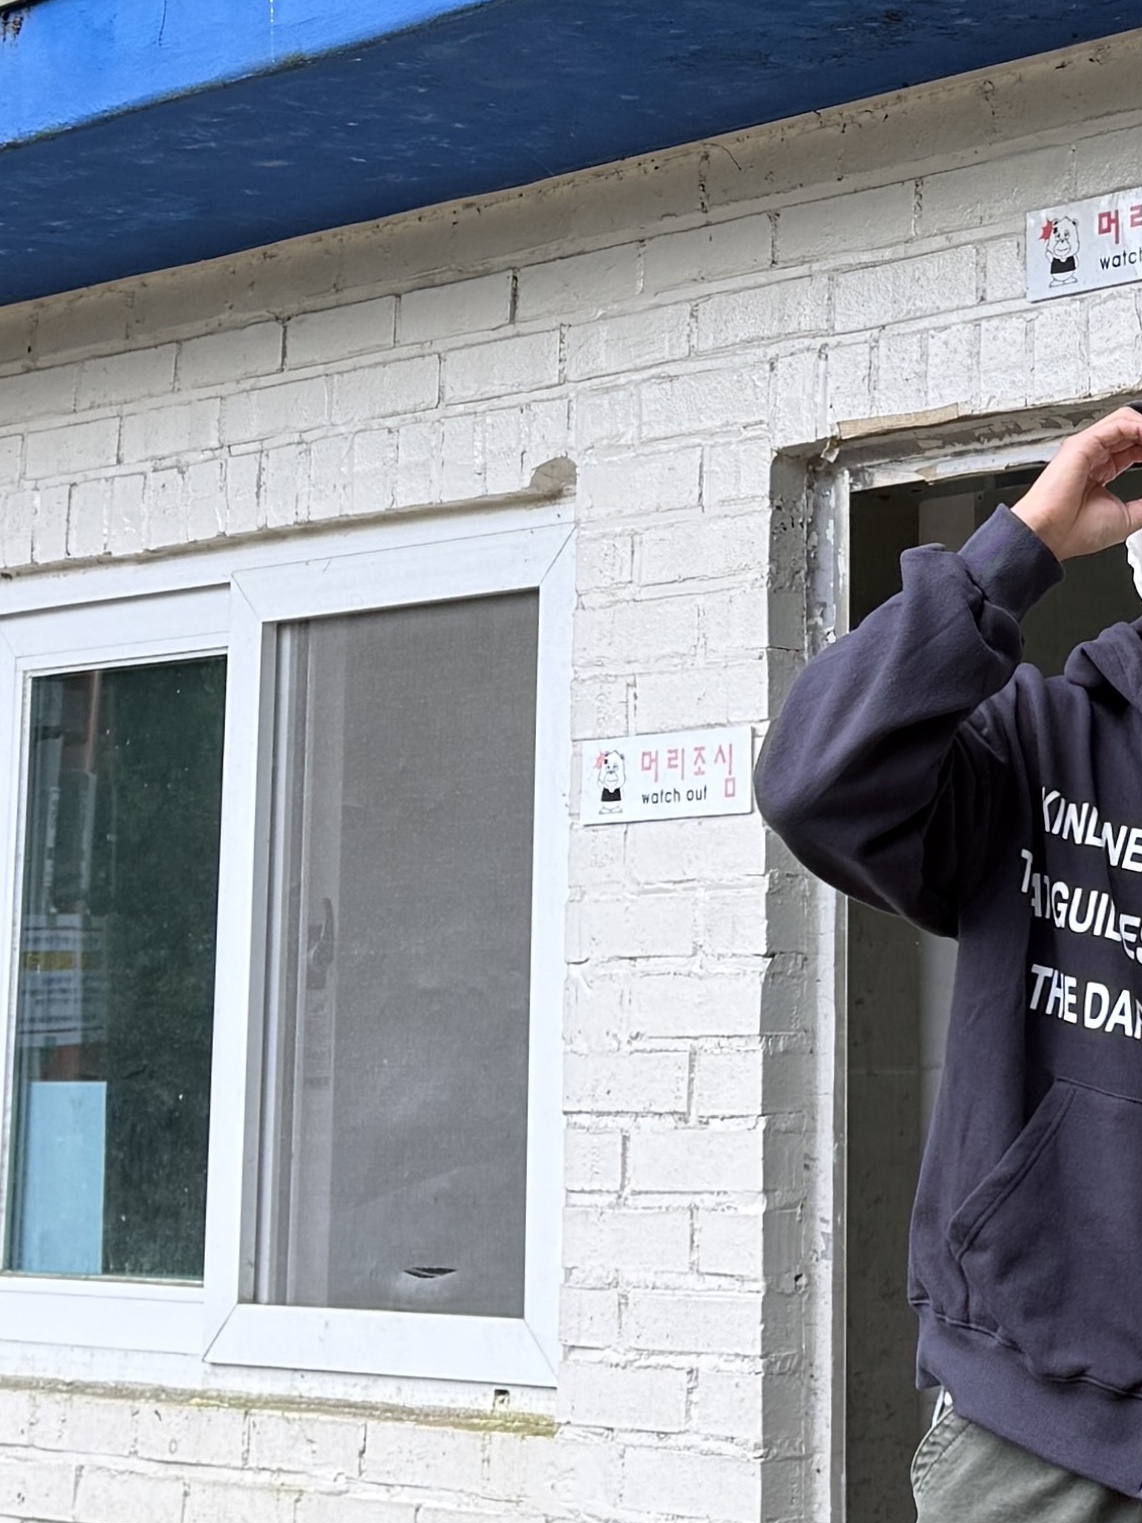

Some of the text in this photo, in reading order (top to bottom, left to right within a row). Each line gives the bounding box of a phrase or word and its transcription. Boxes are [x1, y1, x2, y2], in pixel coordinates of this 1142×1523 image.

[640, 743, 736, 798] 머리조심
[641, 785, 707, 804] watch out
[1029, 963, 1077, 1024] THE
